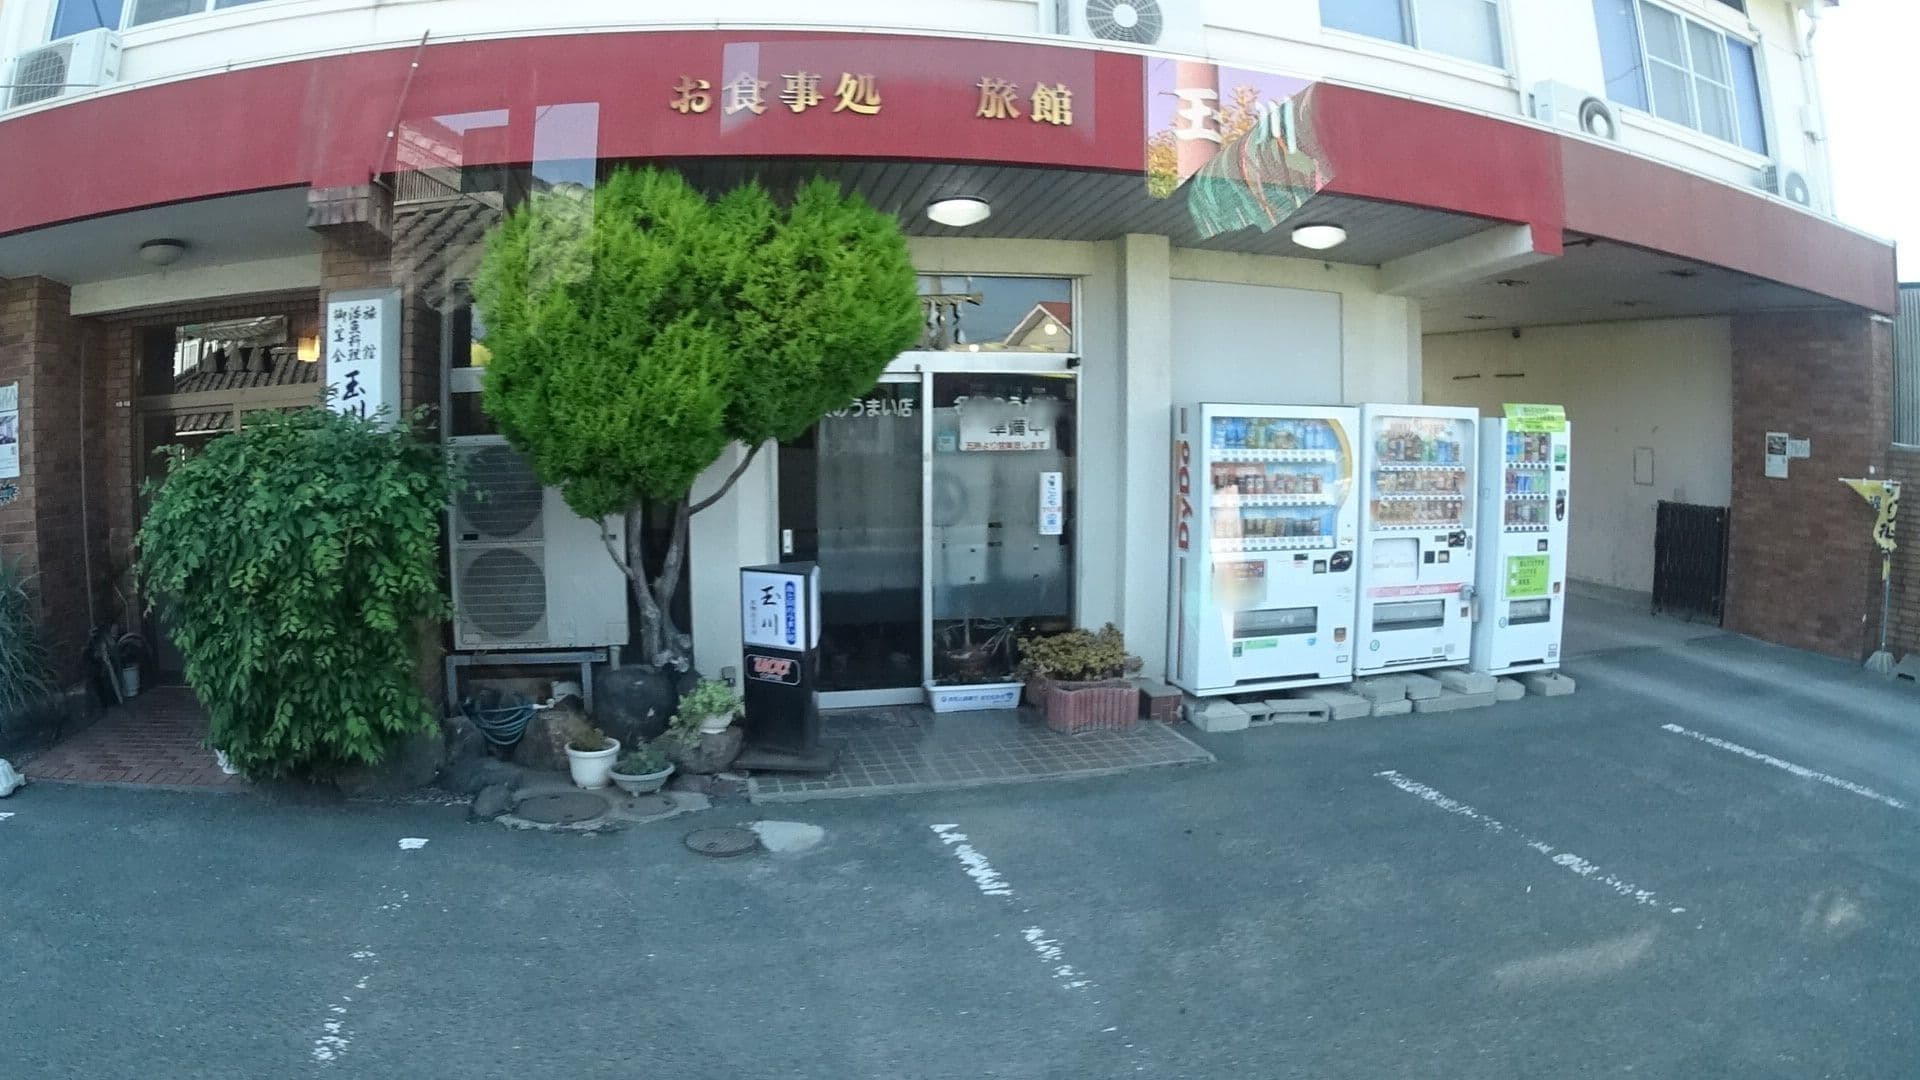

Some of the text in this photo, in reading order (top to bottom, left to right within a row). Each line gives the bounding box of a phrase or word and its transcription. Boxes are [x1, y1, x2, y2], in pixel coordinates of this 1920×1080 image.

[671, 71, 1073, 126] お食事処 旅館
[1174, 88, 1296, 155] 玉川
[760, 585, 782, 637] 玉川
